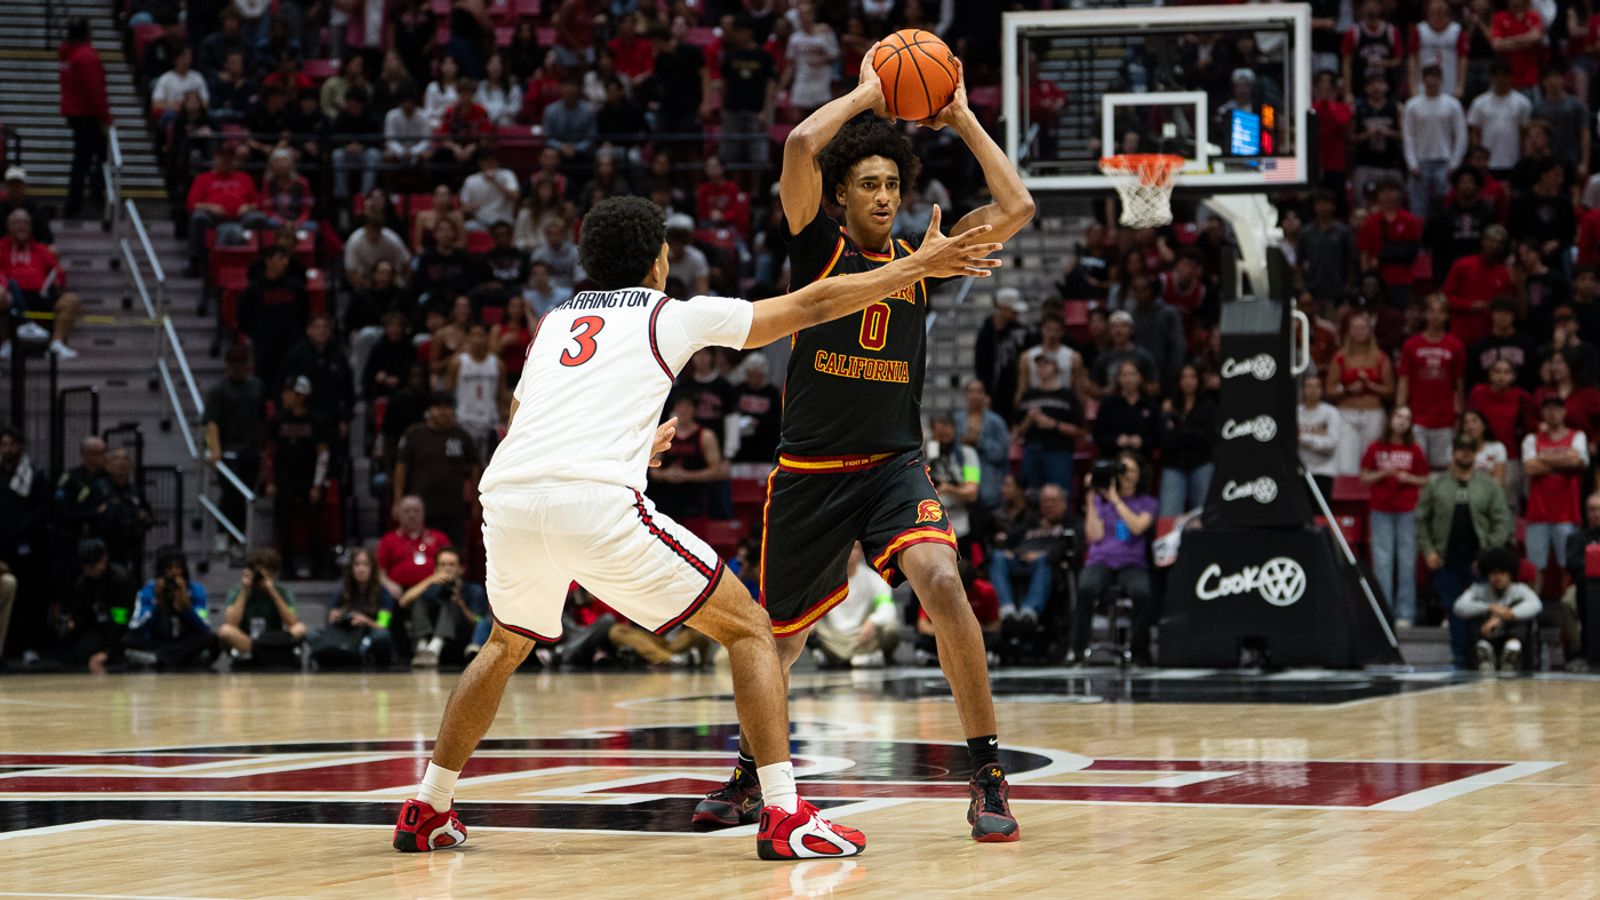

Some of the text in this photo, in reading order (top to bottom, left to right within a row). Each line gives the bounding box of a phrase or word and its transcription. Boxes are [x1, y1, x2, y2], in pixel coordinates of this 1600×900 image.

[559, 315, 605, 367] 3
[859, 301, 891, 351] 0
[815, 350, 909, 383] CALIFORNIA
[1195, 563, 1260, 601] Cook
